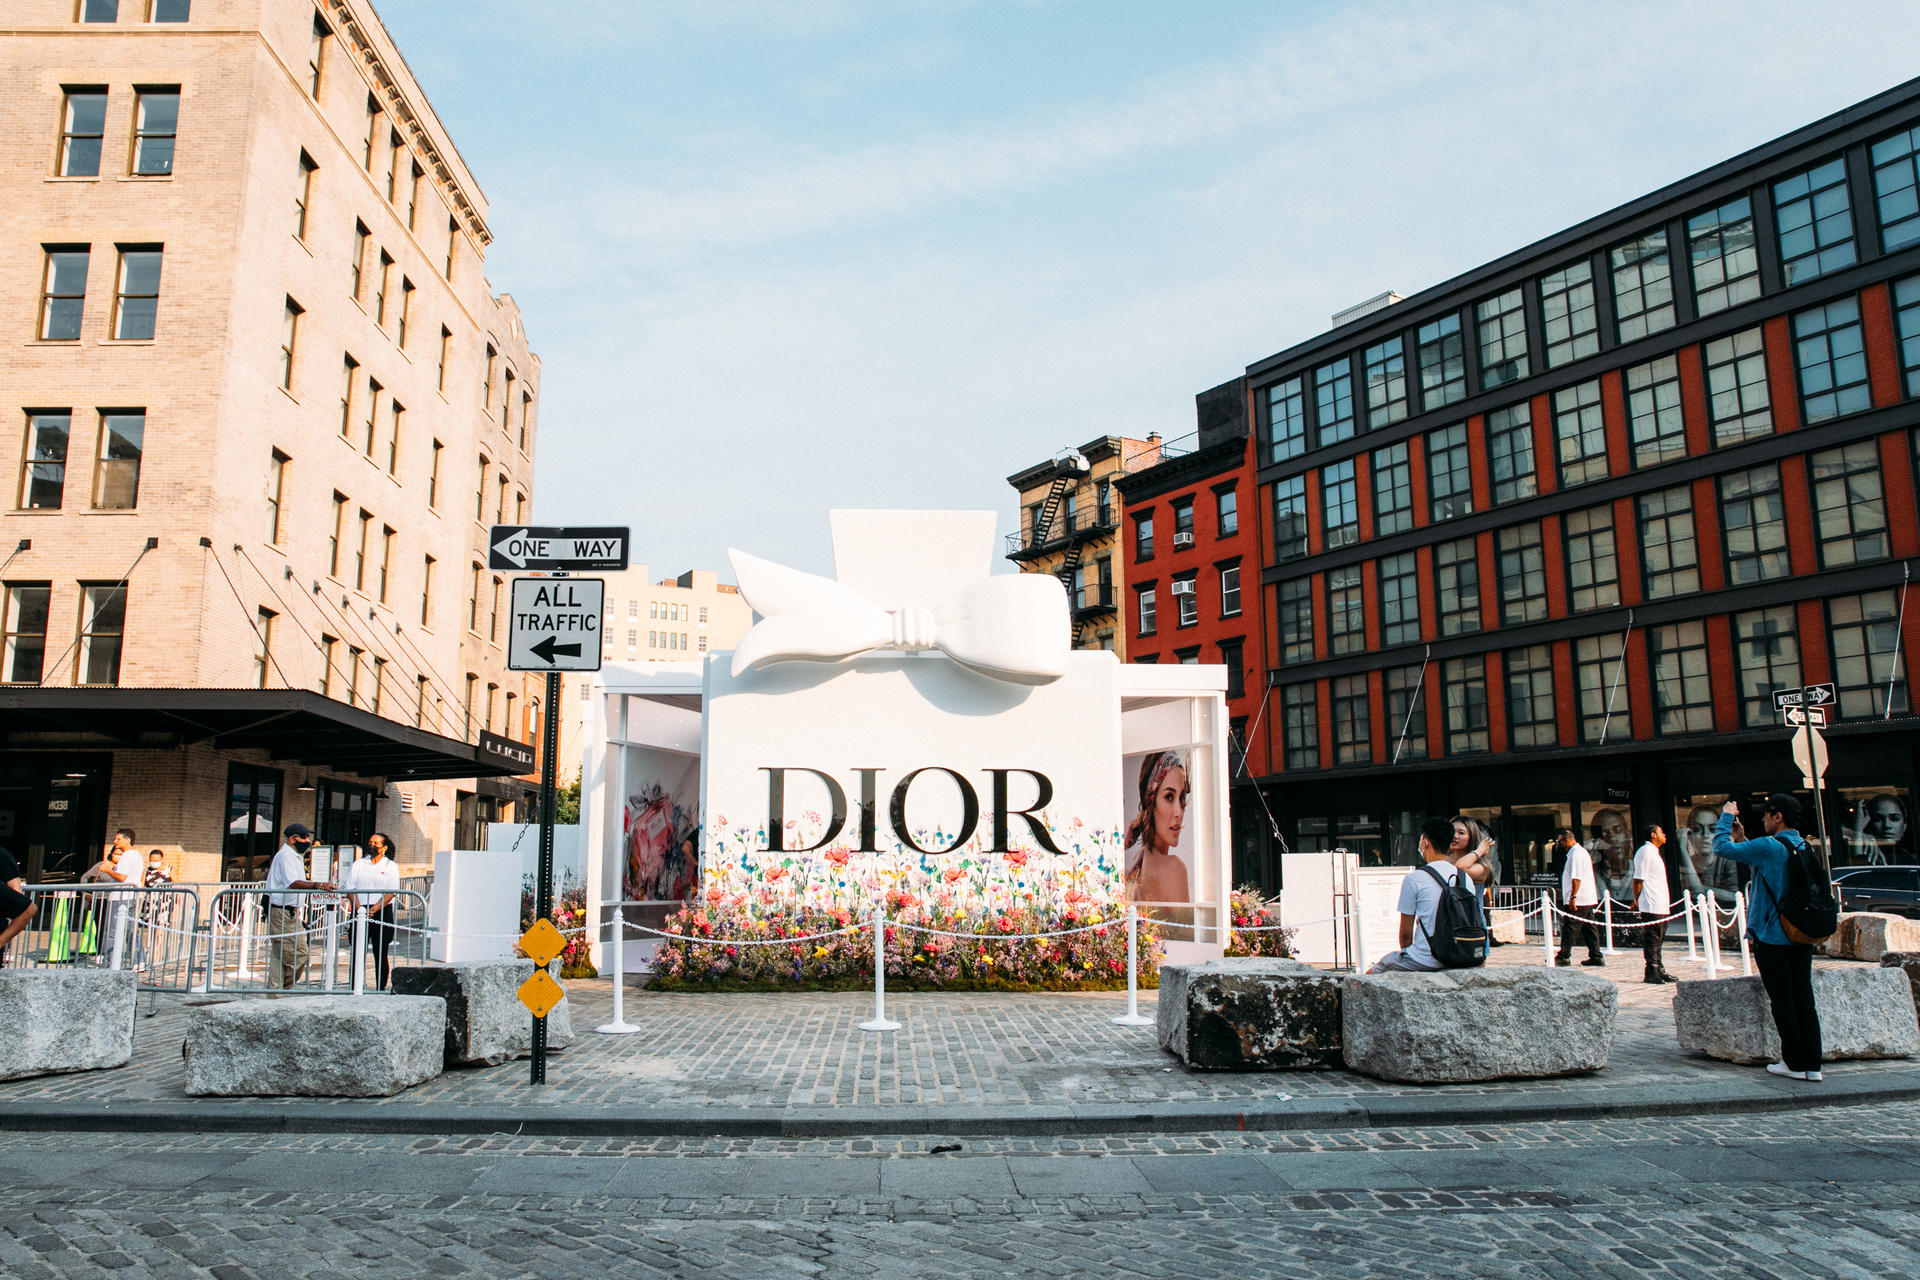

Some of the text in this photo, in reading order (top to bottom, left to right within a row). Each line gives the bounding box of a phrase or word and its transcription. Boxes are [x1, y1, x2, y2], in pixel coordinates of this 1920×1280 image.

[509, 540, 617, 558] ONE WAY
[533, 586, 582, 607] ALL
[517, 613, 597, 632] TRAFFIC
[1782, 690, 1825, 704] ONE WAY
[1791, 712, 1804, 720] ONE
[486, 740, 533, 765] LUCID
[1607, 788, 1630, 799] Theory
[757, 766, 1069, 855] DIOR
